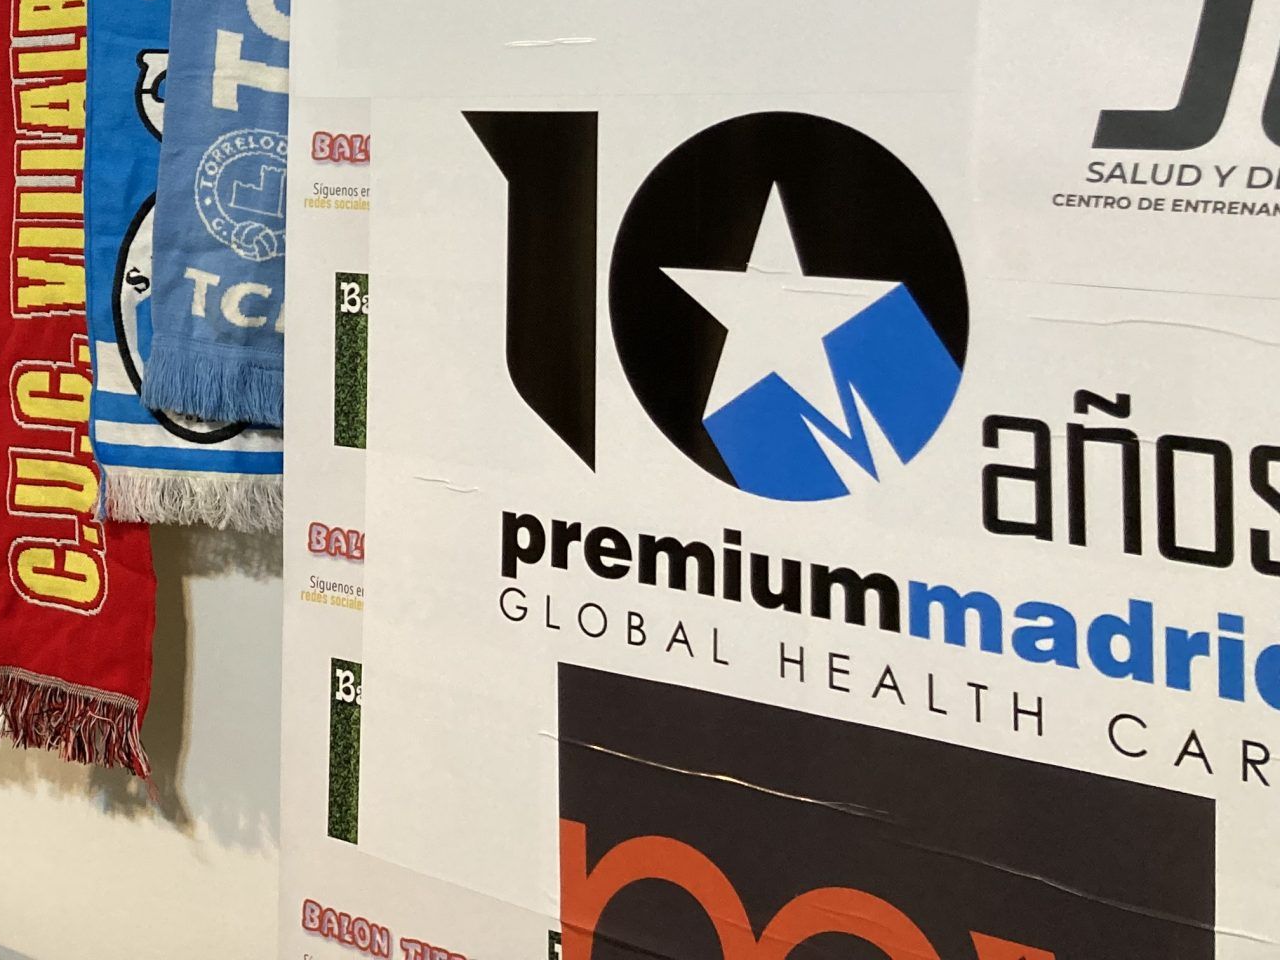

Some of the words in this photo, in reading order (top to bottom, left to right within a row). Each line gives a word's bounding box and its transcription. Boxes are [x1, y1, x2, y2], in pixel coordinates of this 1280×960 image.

[311, 131, 371, 163] BAL
[1085, 161, 1202, 188] SALUD
[1214, 164, 1239, 188] Y
[313, 182, 359, 199] Síguenos
[1052, 193, 1132, 210] CENTRO
[1137, 196, 1165, 212] DE
[308, 521, 365, 561] BAL
[309, 575, 355, 596] Síguenos
[499, 588, 732, 668] GLOBAL
[780, 640, 1045, 737] HEALTH
